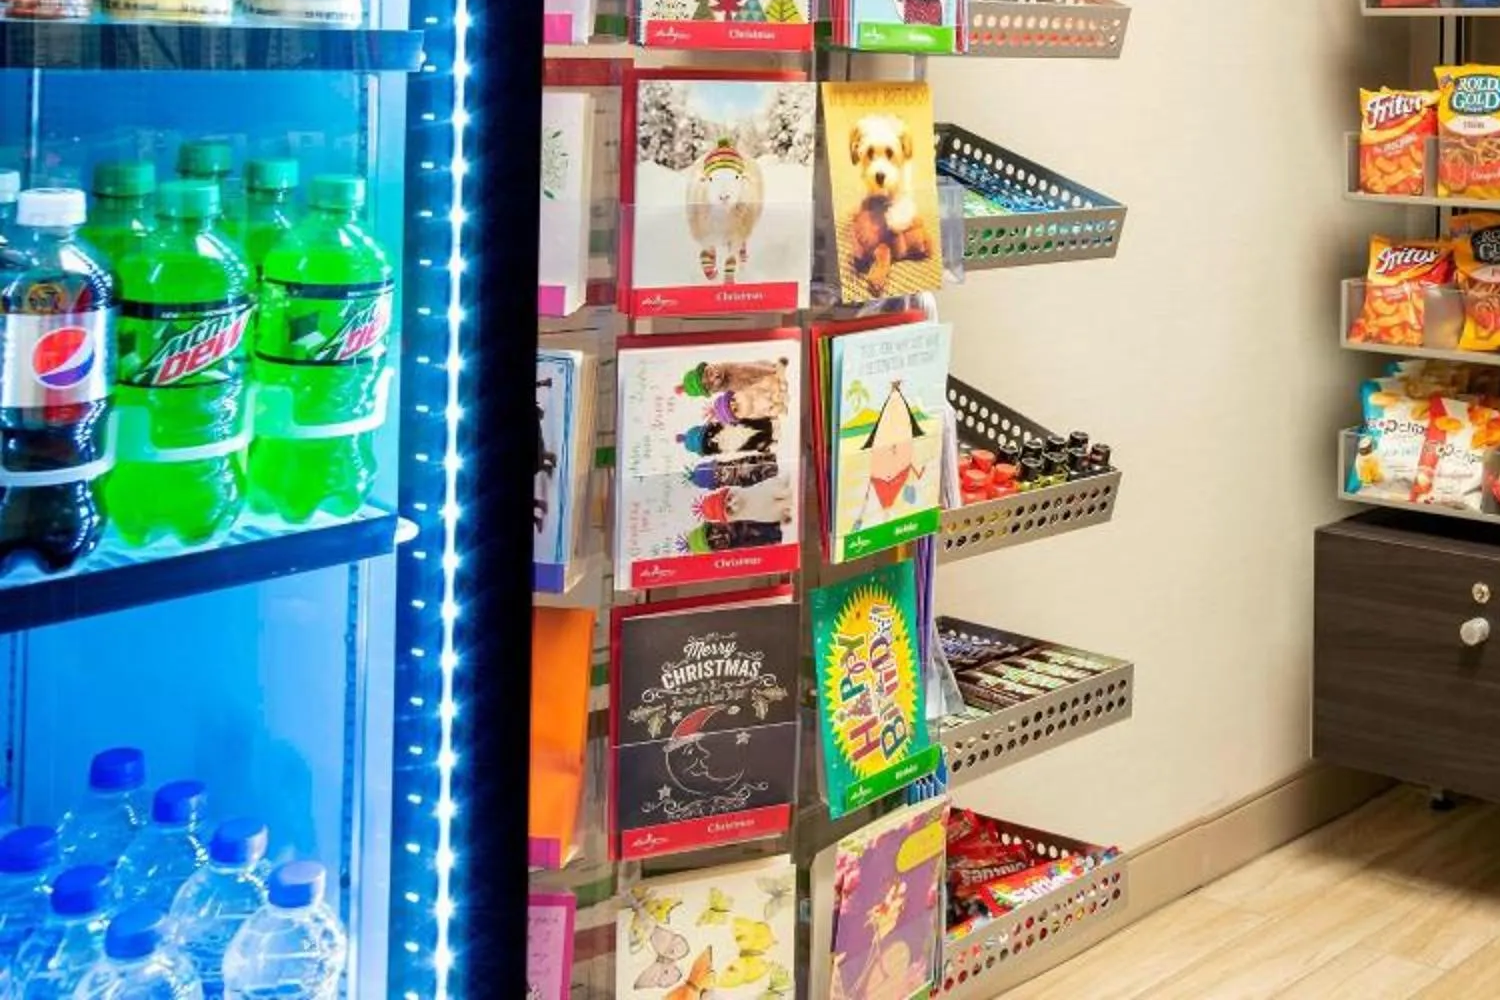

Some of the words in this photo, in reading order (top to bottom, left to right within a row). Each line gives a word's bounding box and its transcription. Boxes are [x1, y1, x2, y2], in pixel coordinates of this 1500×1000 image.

[1376, 247, 1441, 274] Fritos
[683, 640, 738, 659] Merry
[661, 659, 763, 690] CHRISTMAS
